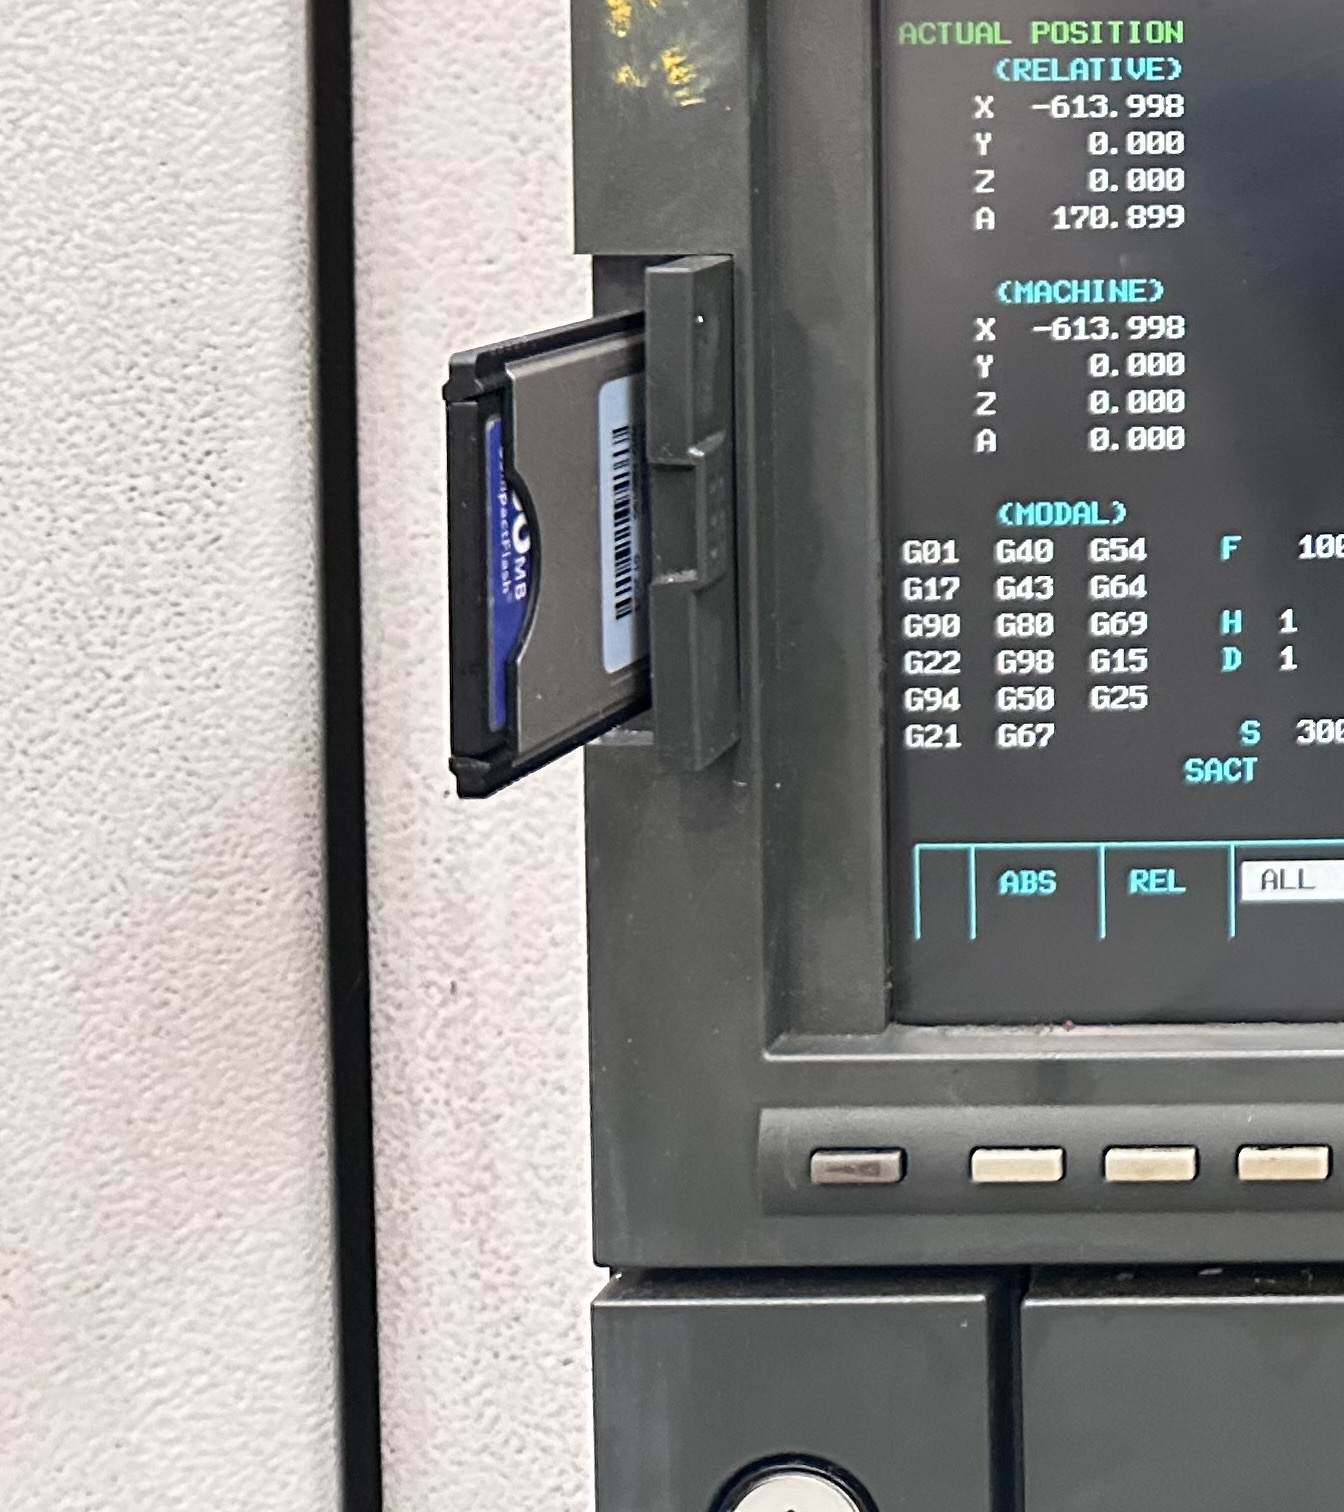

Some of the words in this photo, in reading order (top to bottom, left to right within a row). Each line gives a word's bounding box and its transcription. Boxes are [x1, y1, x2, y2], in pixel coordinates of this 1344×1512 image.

[899, 21, 1013, 45] ACTUAL
[1030, 20, 1184, 45] POSITION
[995, 56, 1182, 82] (RELATIVE)
[974, 95, 995, 119] X
[1031, 93, 1185, 119] -613.998
[974, 132, 992, 156] Y
[1087, 130, 1185, 156] 0.000
[974, 169, 995, 194] Z
[1088, 167, 1185, 193] 0.000
[974, 206, 996, 231] A
[1052, 204, 1185, 230] 170.899
[996, 278, 1164, 305] (MACHINE)
[998, 500, 1127, 527] (MODAL)
[902, 539, 960, 565] G01
[995, 538, 1054, 564] G40
[1088, 537, 1148, 563] G54
[1220, 535, 1242, 561] F
[903, 576, 960, 602] G17
[995, 575, 1054, 601] G43
[1089, 574, 1148, 600] G64
[903, 613, 961, 639] G90
[995, 612, 1055, 638] G80
[1089, 611, 1148, 637] G69
[1240, 720, 1261, 746] S
[1184, 756, 1258, 784] SACT
[999, 869, 1057, 895] ABS
[1129, 868, 1187, 895] REL
[1261, 869, 1316, 890] ALL
